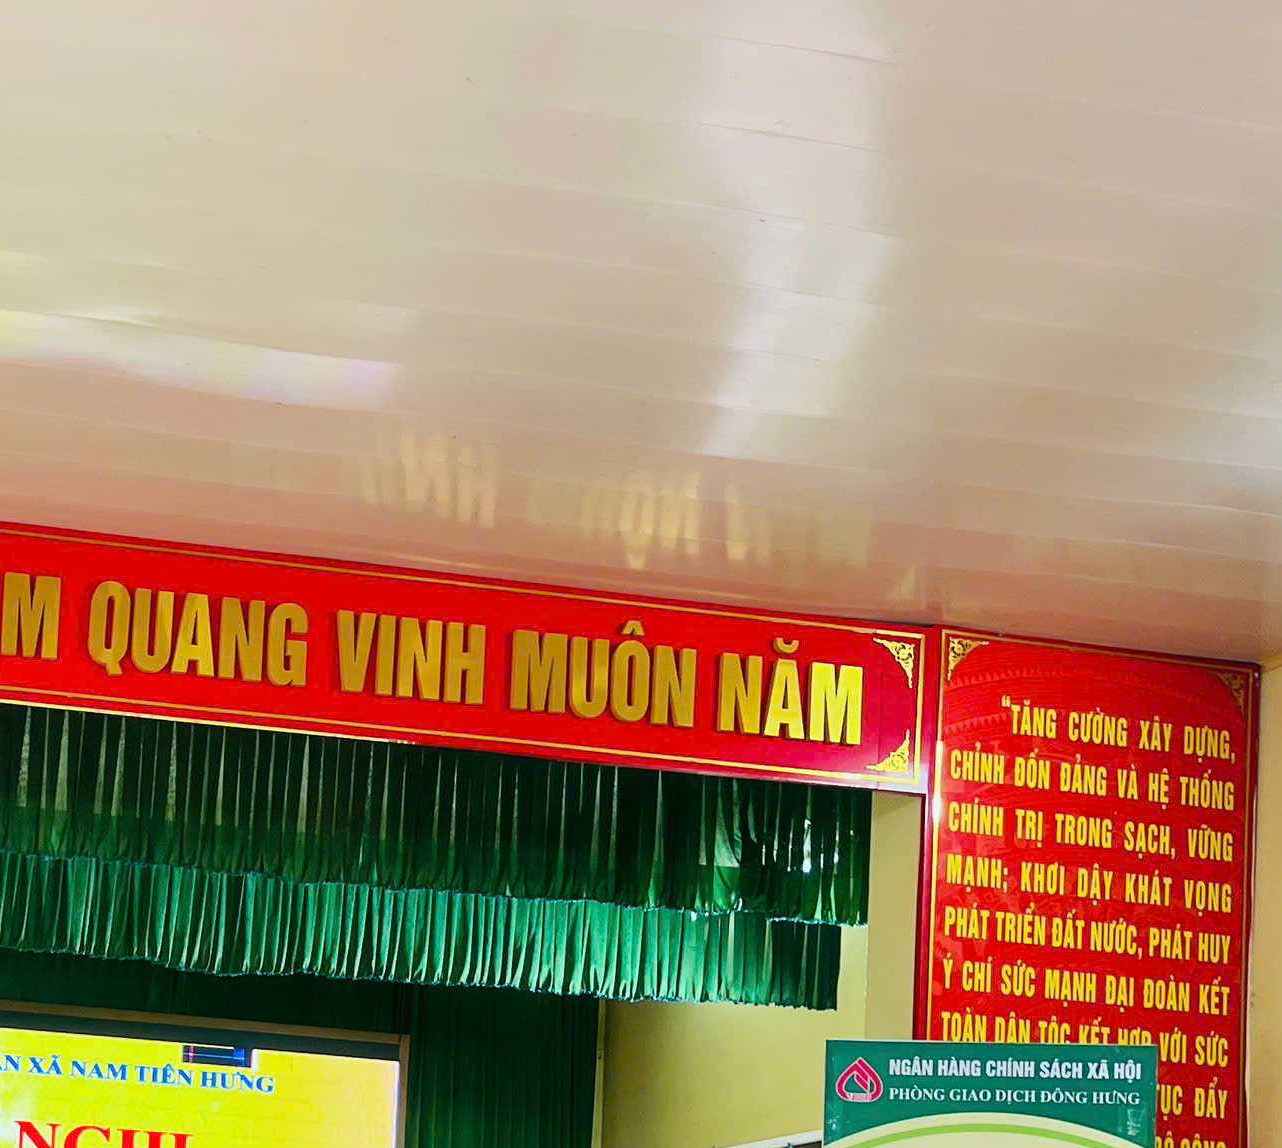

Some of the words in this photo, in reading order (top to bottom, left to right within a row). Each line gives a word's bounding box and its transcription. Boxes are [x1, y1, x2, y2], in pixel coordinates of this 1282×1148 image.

[87, 580, 308, 688] QUANG
[337, 609, 486, 706] VINH
[510, 620, 696, 729] MUÔN
[717, 641, 864, 746] NĂM
[1002, 695, 1056, 738] “TĂNG
[1069, 708, 1127, 747] CƯỜNG
[1139, 716, 1171, 751] XÂY
[1184, 726, 1234, 762] DỰNG,
[950, 742, 1004, 784] CHỈNH
[1014, 748, 1050, 789] ĐỐN
[1060, 754, 1107, 796] ĐẢNG
[1118, 764, 1138, 799] VÀ
[1149, 768, 1169, 809] HỆ
[1180, 770, 1233, 810] THỐNG
[946, 798, 1004, 836] CHÍNH
[1016, 809, 1043, 847] TRỊ
[1055, 814, 1112, 848] TRONG
[1124, 822, 1175, 859] SẠCH,
[1188, 824, 1232, 861] VỮNG
[945, 902, 990, 939] PHÁT
[996, 902, 1046, 945] TRIỂN
[1052, 912, 1085, 949] ĐẤT
[1090, 918, 1142, 959] NƯỚC,
[1149, 924, 1192, 960] PHÁT
[1199, 933, 1230, 964] HUY
[30, 1056, 62, 1076] XÃ
[70, 1060, 128, 1080] NAM
[135, 1064, 192, 1086] TIÊN
[201, 1071, 274, 1092] HƯNG
[890, 1056, 933, 1075] NGÂN
[938, 1057, 981, 1076] HÀNG
[986, 1058, 1034, 1077] CHÍNH
[1040, 1059, 1082, 1078] SÁCH
[1087, 1060, 1109, 1079] XÃ
[1114, 1060, 1141, 1083] HỘI
[890, 1085, 944, 1100] PHÒNG
[950, 1089, 991, 1101] GIAO
[996, 1090, 1035, 1102] DỊCH
[1041, 1088, 1086, 1103] ĐÔNG
[1093, 1091, 1139, 1104] HƯNG
